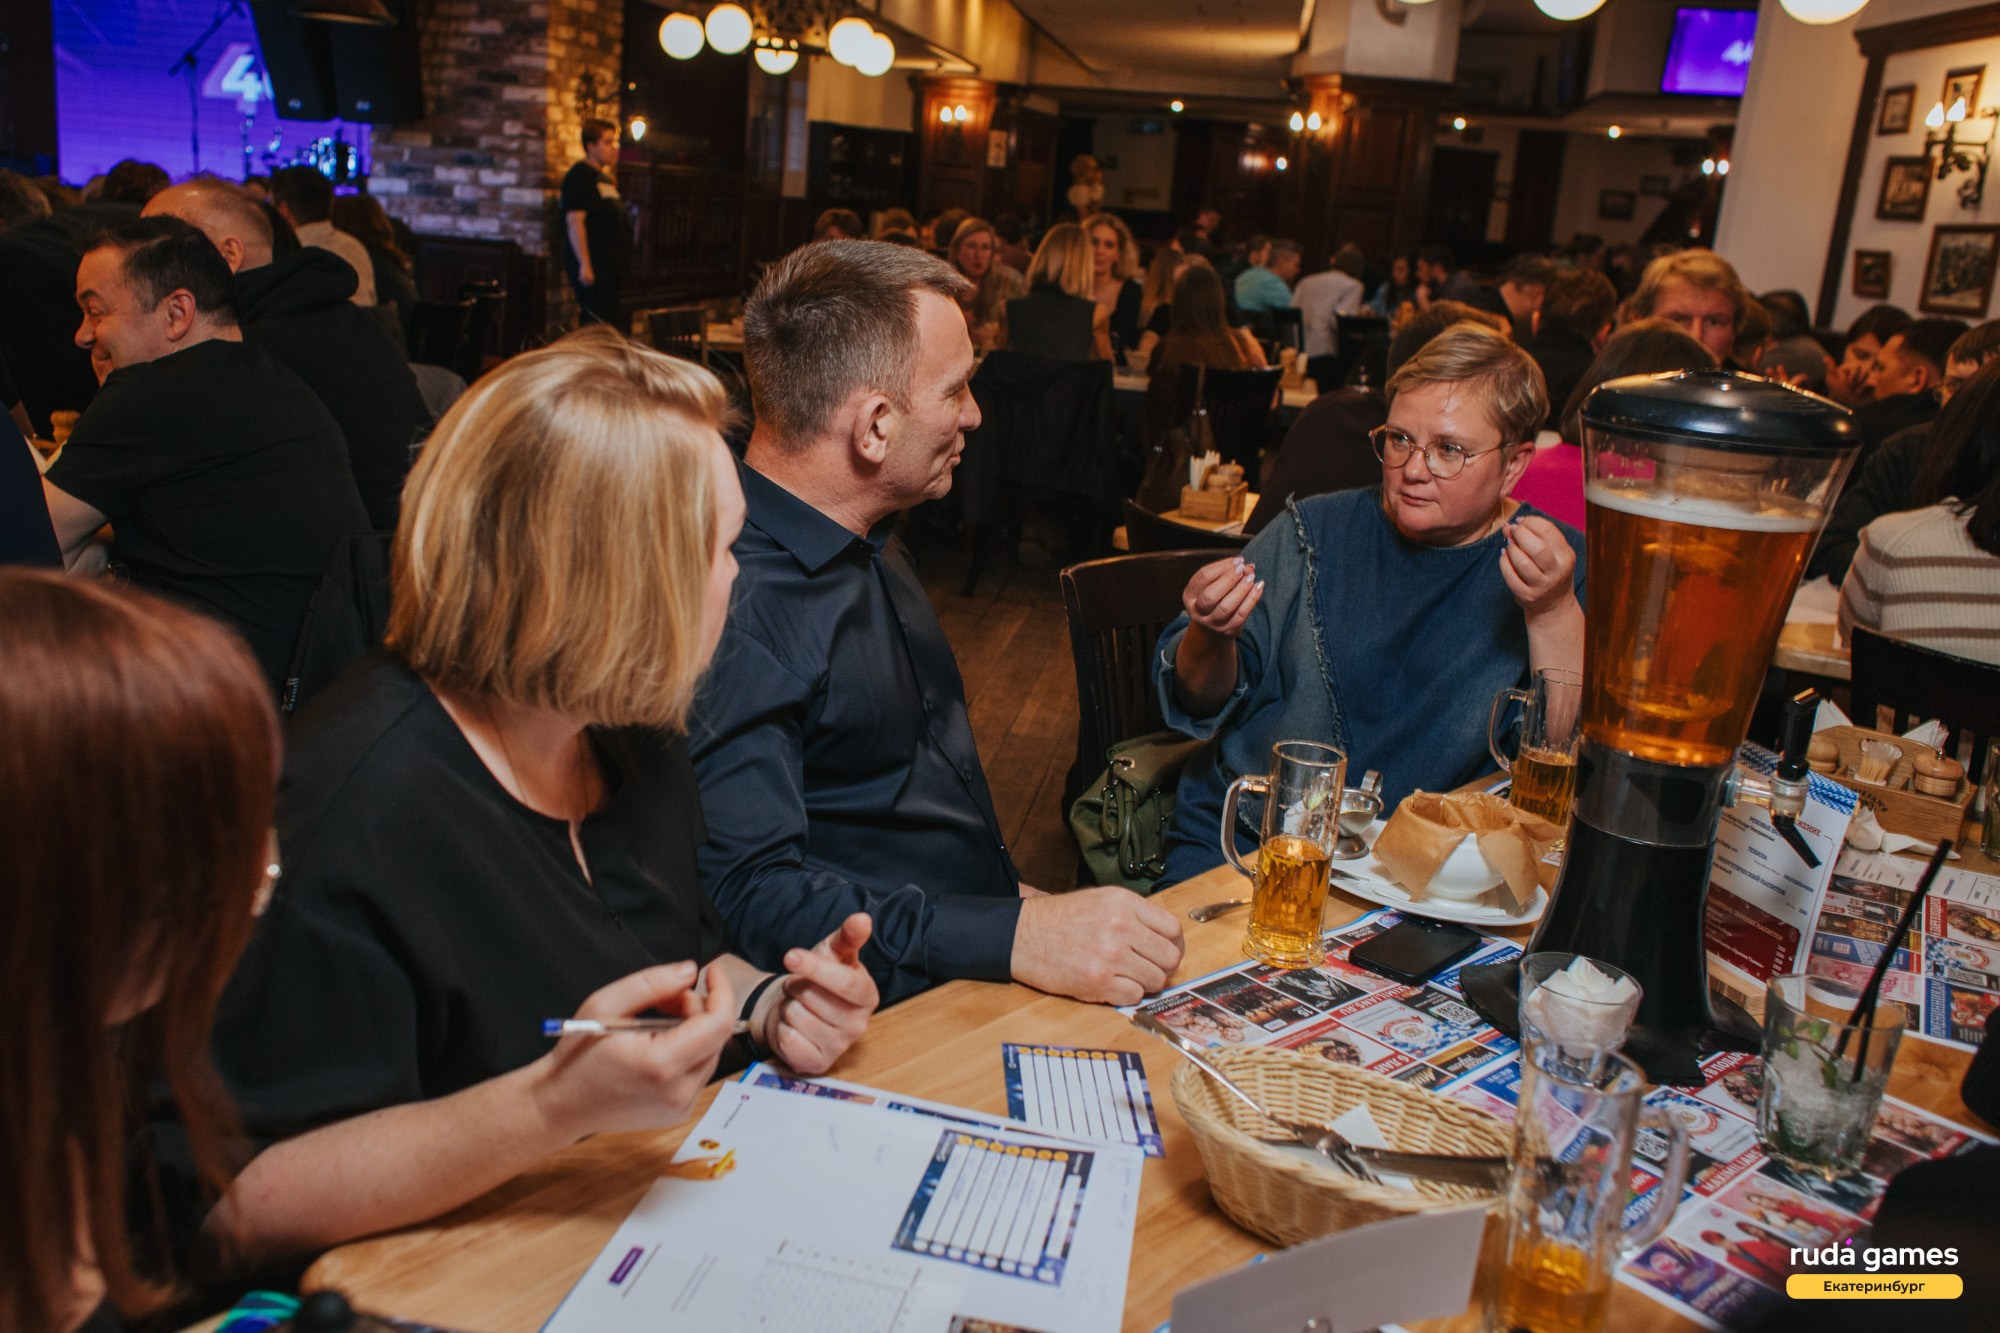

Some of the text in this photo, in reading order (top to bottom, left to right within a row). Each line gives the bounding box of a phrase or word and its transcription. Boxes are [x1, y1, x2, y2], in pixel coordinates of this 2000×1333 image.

[1797, 820, 1822, 836] ЖЕНИЕ
[1338, 984, 1409, 1016] AXIMILIANS.RU
[1702, 1149, 1763, 1192] MAXIMILIANS
